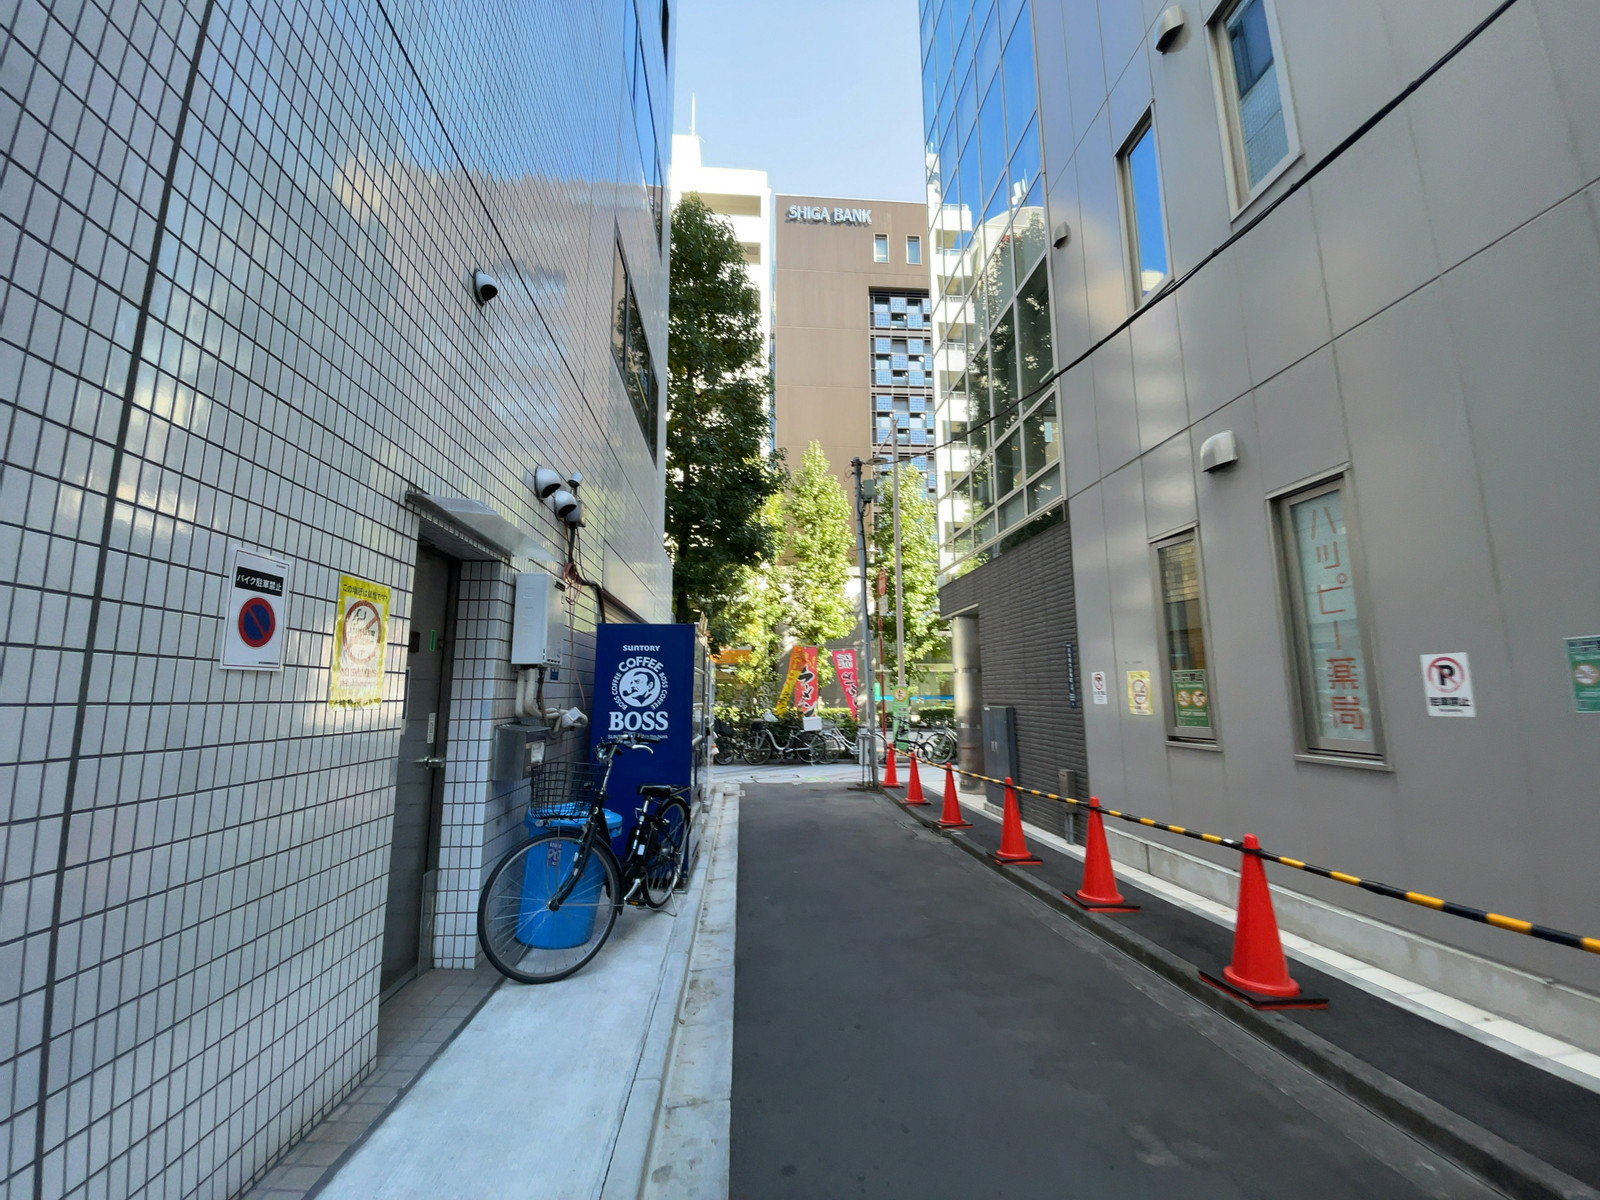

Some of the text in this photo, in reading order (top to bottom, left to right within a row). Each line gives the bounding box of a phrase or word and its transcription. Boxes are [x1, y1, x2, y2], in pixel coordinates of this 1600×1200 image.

[788, 204, 872, 225] SHIGA BANK
[236, 574, 282, 592] バイク駐車禁止
[618, 656, 664, 672] COFFEE
[612, 672, 628, 710] BOSS COFFEE
[651, 672, 668, 710] BOSS COFFEE
[608, 711, 669, 731] BOSS
